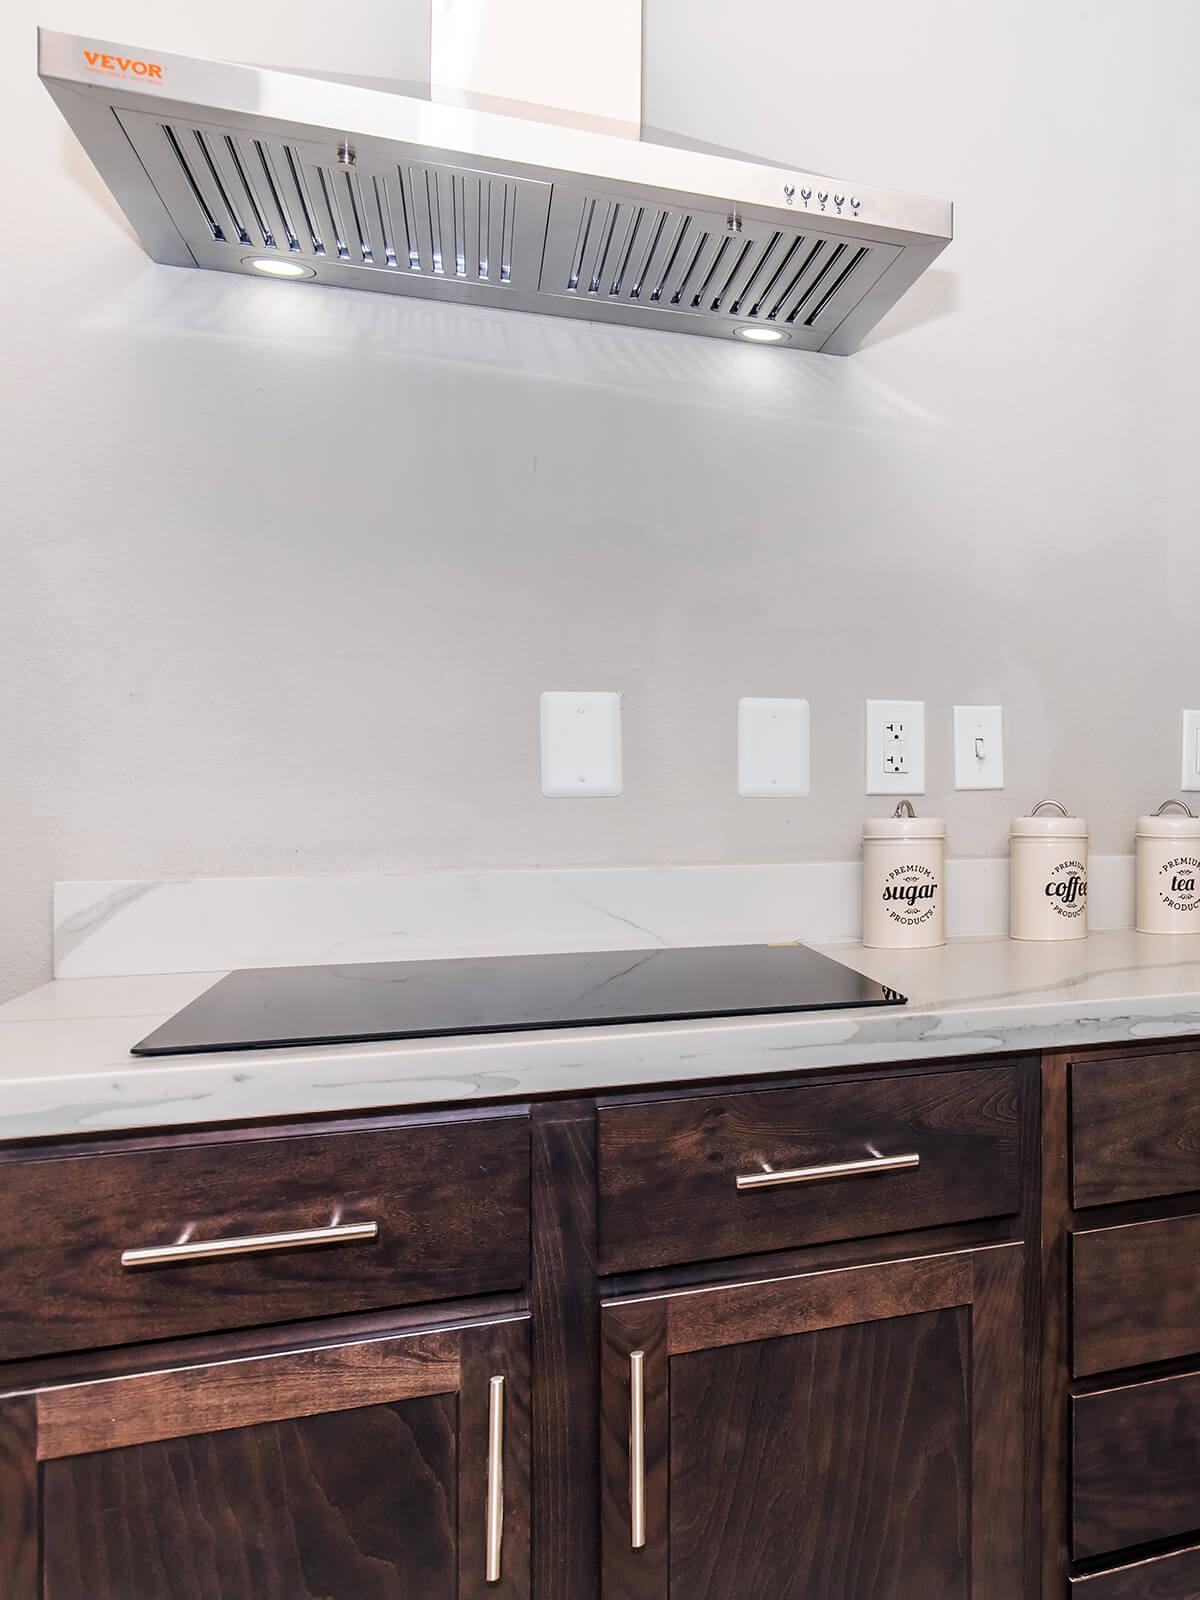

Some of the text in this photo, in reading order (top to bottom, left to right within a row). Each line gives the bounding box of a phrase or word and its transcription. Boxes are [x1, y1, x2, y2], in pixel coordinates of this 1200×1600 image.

[84, 50, 162, 79] VEVOR
[889, 864, 931, 879] PREMIUM
[1171, 876, 1195, 891] tea
[882, 884, 938, 906] sugar
[889, 909, 934, 925] PRODUCTS
